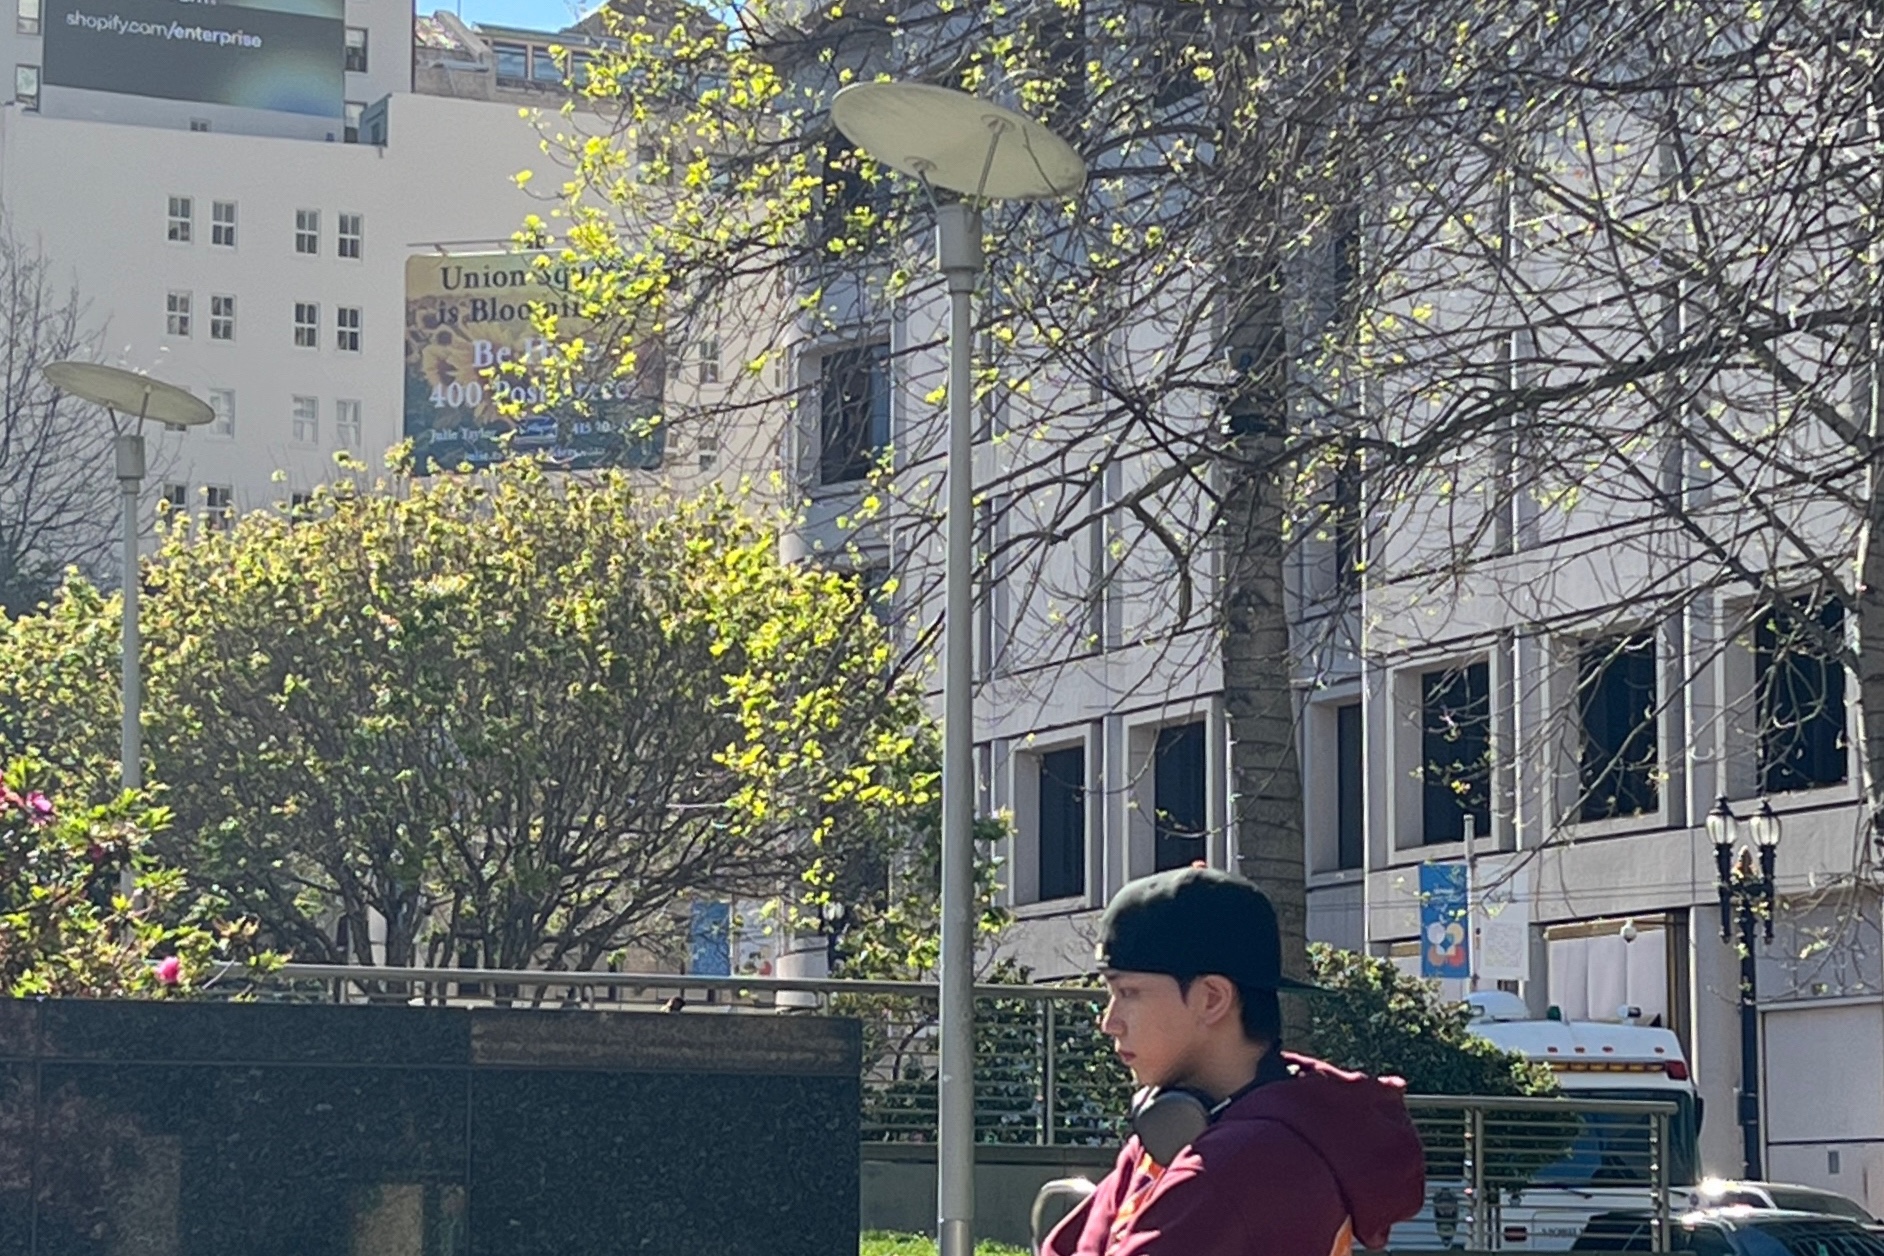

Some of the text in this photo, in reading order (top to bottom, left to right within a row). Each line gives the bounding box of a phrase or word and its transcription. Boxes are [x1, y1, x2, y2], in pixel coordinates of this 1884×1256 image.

[66, 10, 262, 48] shopify.com/enterprise
[441, 265, 527, 290] Union
[438, 298, 581, 324] is Bloomi
[473, 339, 512, 368] Be
[429, 381, 483, 408] 400
